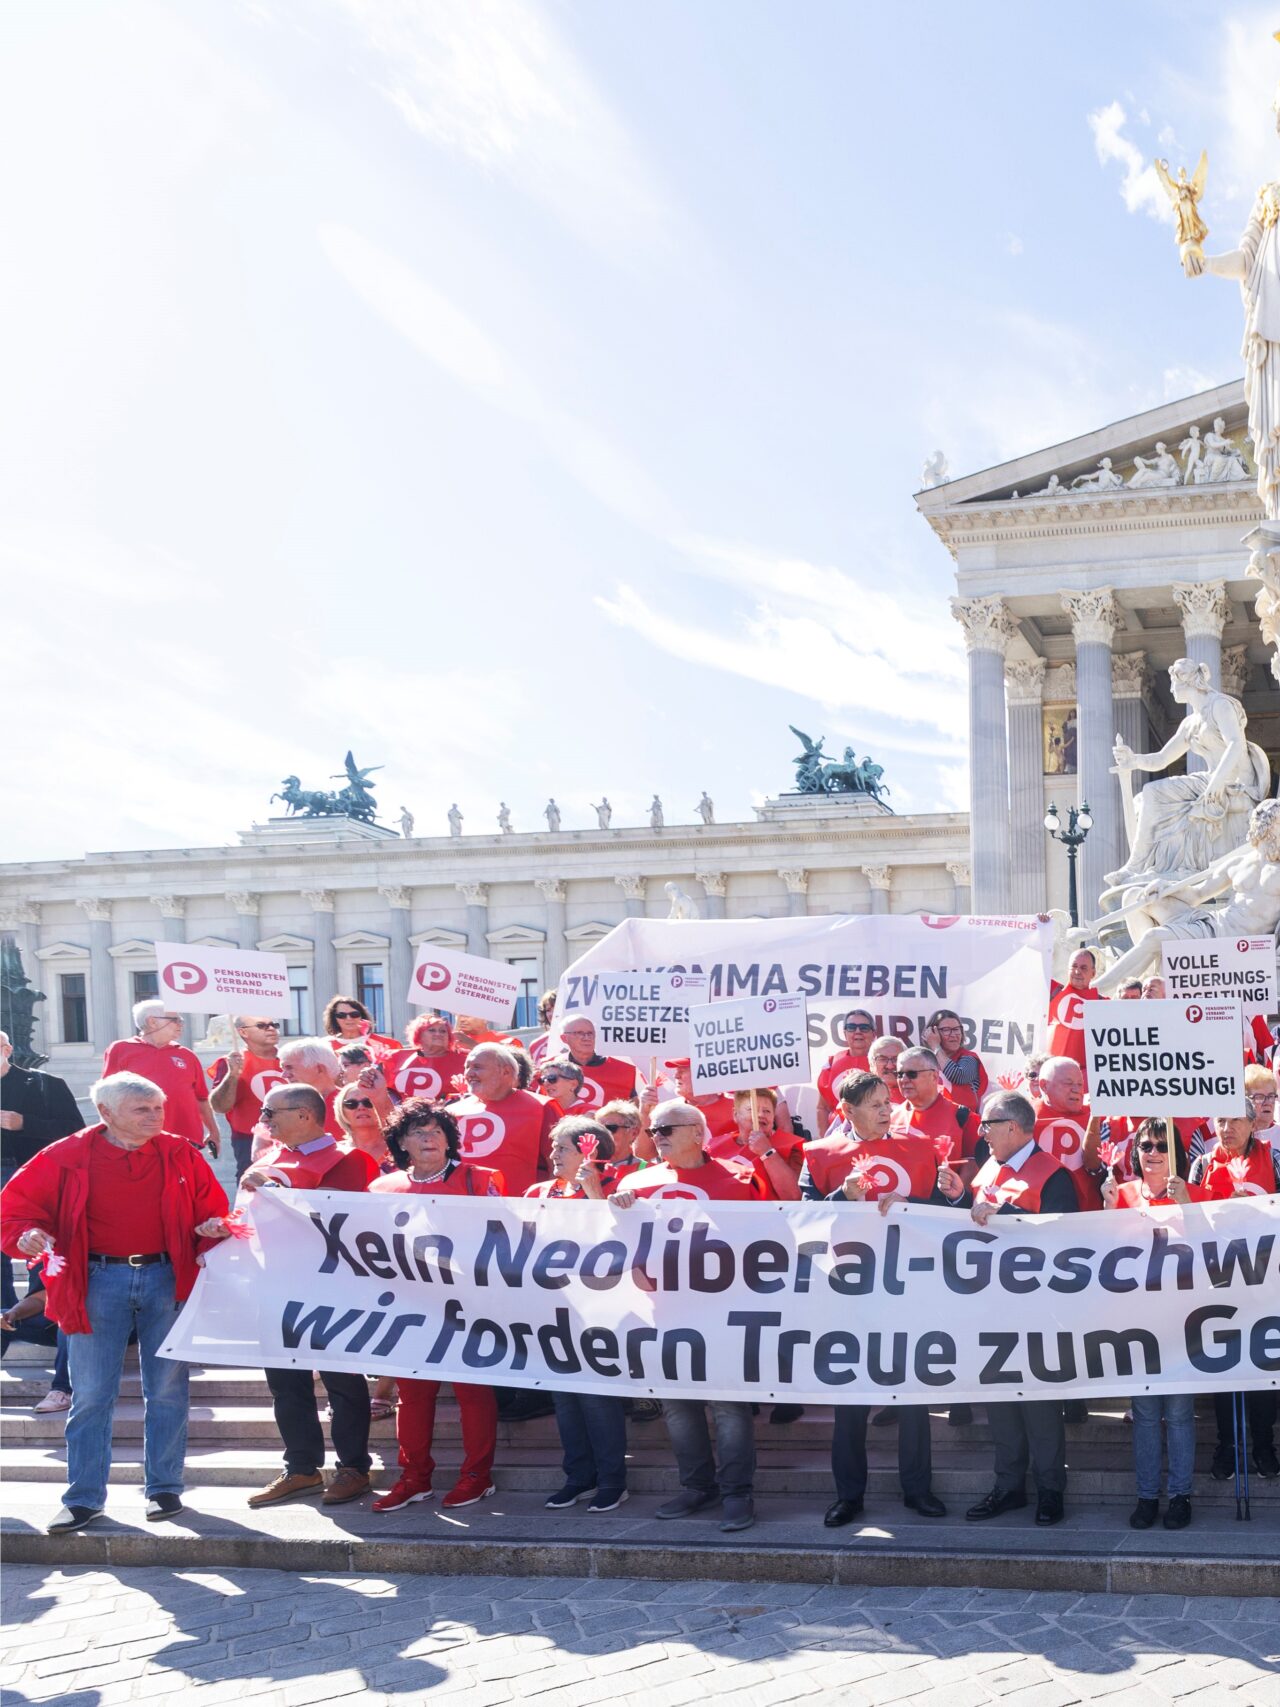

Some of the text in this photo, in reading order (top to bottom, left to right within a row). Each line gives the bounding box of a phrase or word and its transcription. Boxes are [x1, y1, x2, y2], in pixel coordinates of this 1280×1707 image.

[1167, 954, 1219, 971] VOLLE
[214, 968, 286, 981] PENSIONISTEN
[215, 977, 263, 987] VERBAND
[458, 972, 517, 991] PENSIONISTEN
[797, 963, 948, 999] SIEBEN
[1169, 970, 1272, 989] TEUERUNGS-
[216, 984, 284, 997] ÖSTERREICHS
[454, 987, 510, 1005] ÖSTERREICHS
[456, 980, 495, 994] VERBAND
[603, 984, 661, 1001] VOLLE
[600, 1027, 667, 1044] TREUE!
[694, 1016, 744, 1038] VOLLE
[694, 1031, 802, 1059] TEUERUNGS-
[1091, 1027, 1160, 1047] VOLLE
[696, 1051, 800, 1079] ABGELTUNG!
[1094, 1052, 1215, 1072] PENSIONS-
[1096, 1077, 1236, 1097] ANPASSUNG!
[309, 1210, 455, 1287] Kein
[281, 1290, 427, 1357] wir
[425, 1298, 707, 1382] fordern
[727, 1310, 957, 1387] Treue
[978, 1327, 1162, 1385] zum
